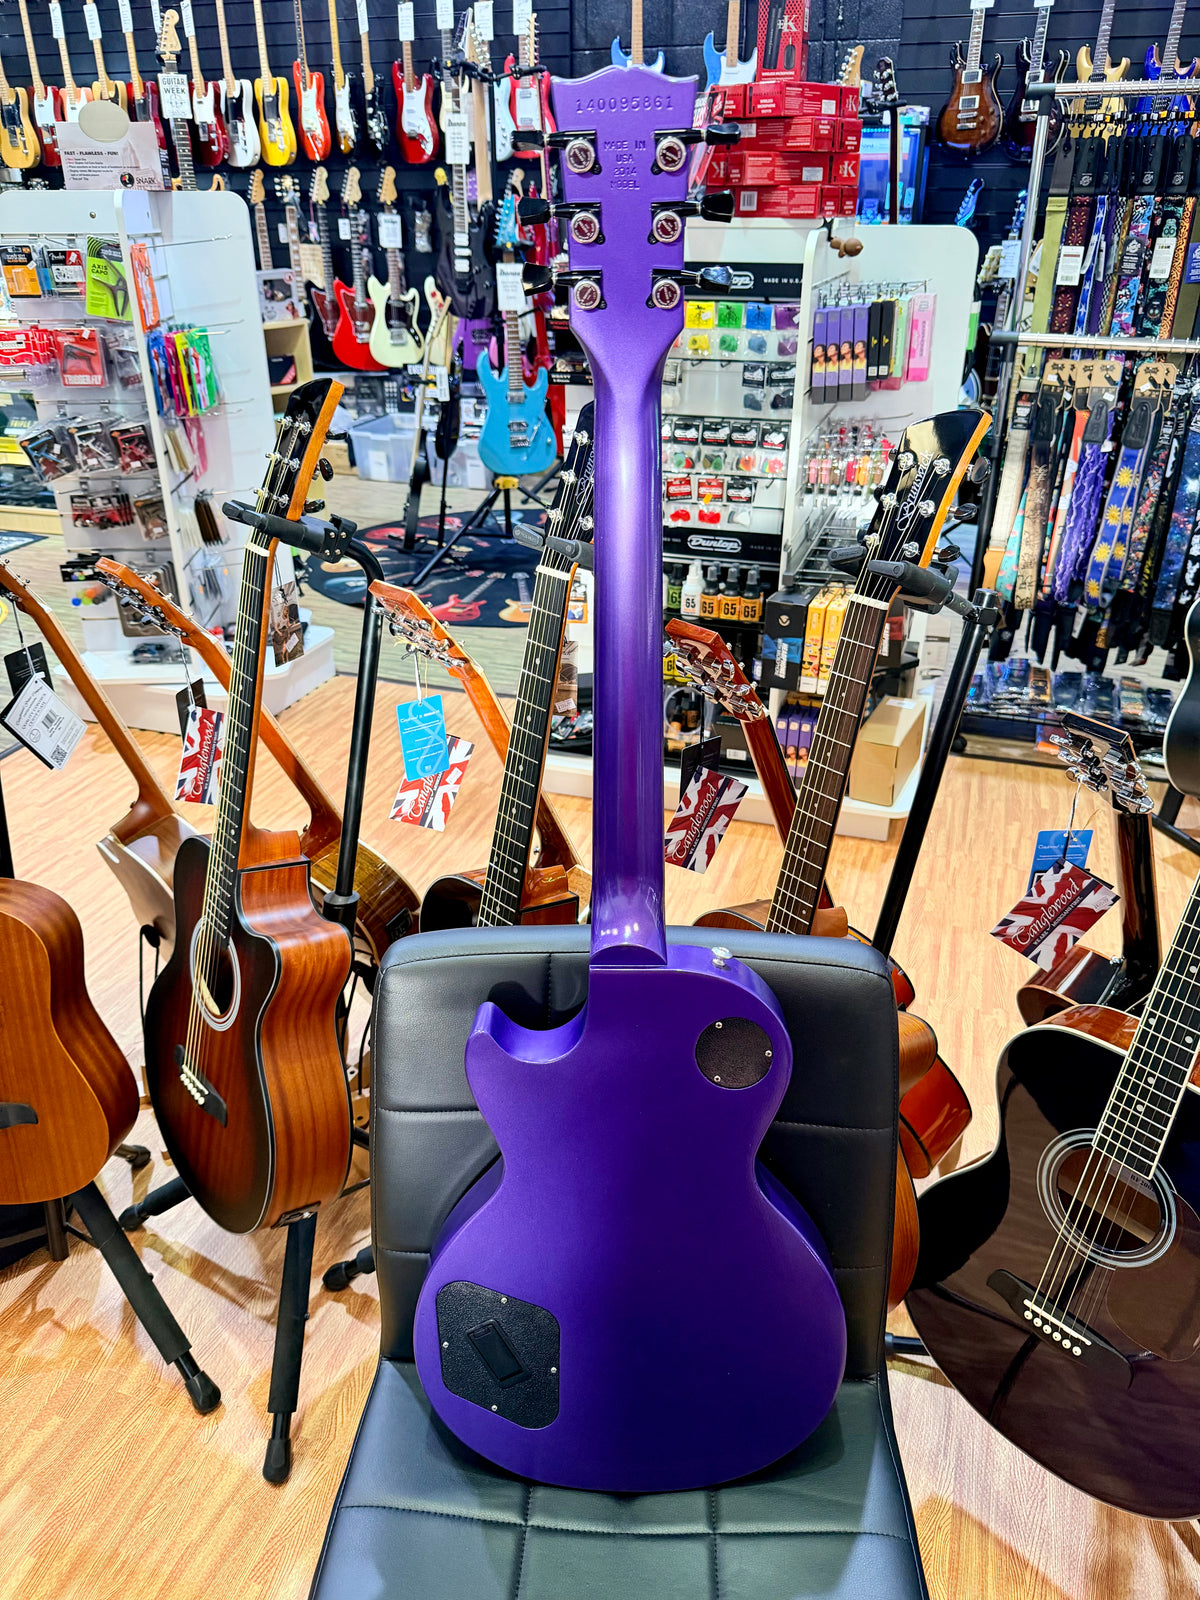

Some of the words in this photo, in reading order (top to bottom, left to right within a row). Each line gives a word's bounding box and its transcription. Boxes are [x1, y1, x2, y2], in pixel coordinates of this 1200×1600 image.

[162, 77, 185, 86] GUITAR
[575, 95, 674, 114] 140095861
[603, 140, 629, 151] MADE
[635, 139, 647, 151] IN
[616, 153, 634, 164] USA
[613, 166, 637, 177] 2014
[135, 177, 157, 185] SNARK
[610, 180, 640, 190] MODEL
[91, 263, 108, 271] AXIS
[91, 268, 109, 276] CAPO
[897, 450, 935, 531] Brunswick
[690, 537, 739, 550] Dunlop
[685, 598, 696, 609] 65
[701, 601, 714, 615] 65
[723, 603, 737, 616] 65
[743, 606, 756, 619] 65
[190, 718, 214, 798] Tanglewood
[672, 782, 717, 861] Tanglewood
[1011, 877, 1080, 946] Tanglewood
